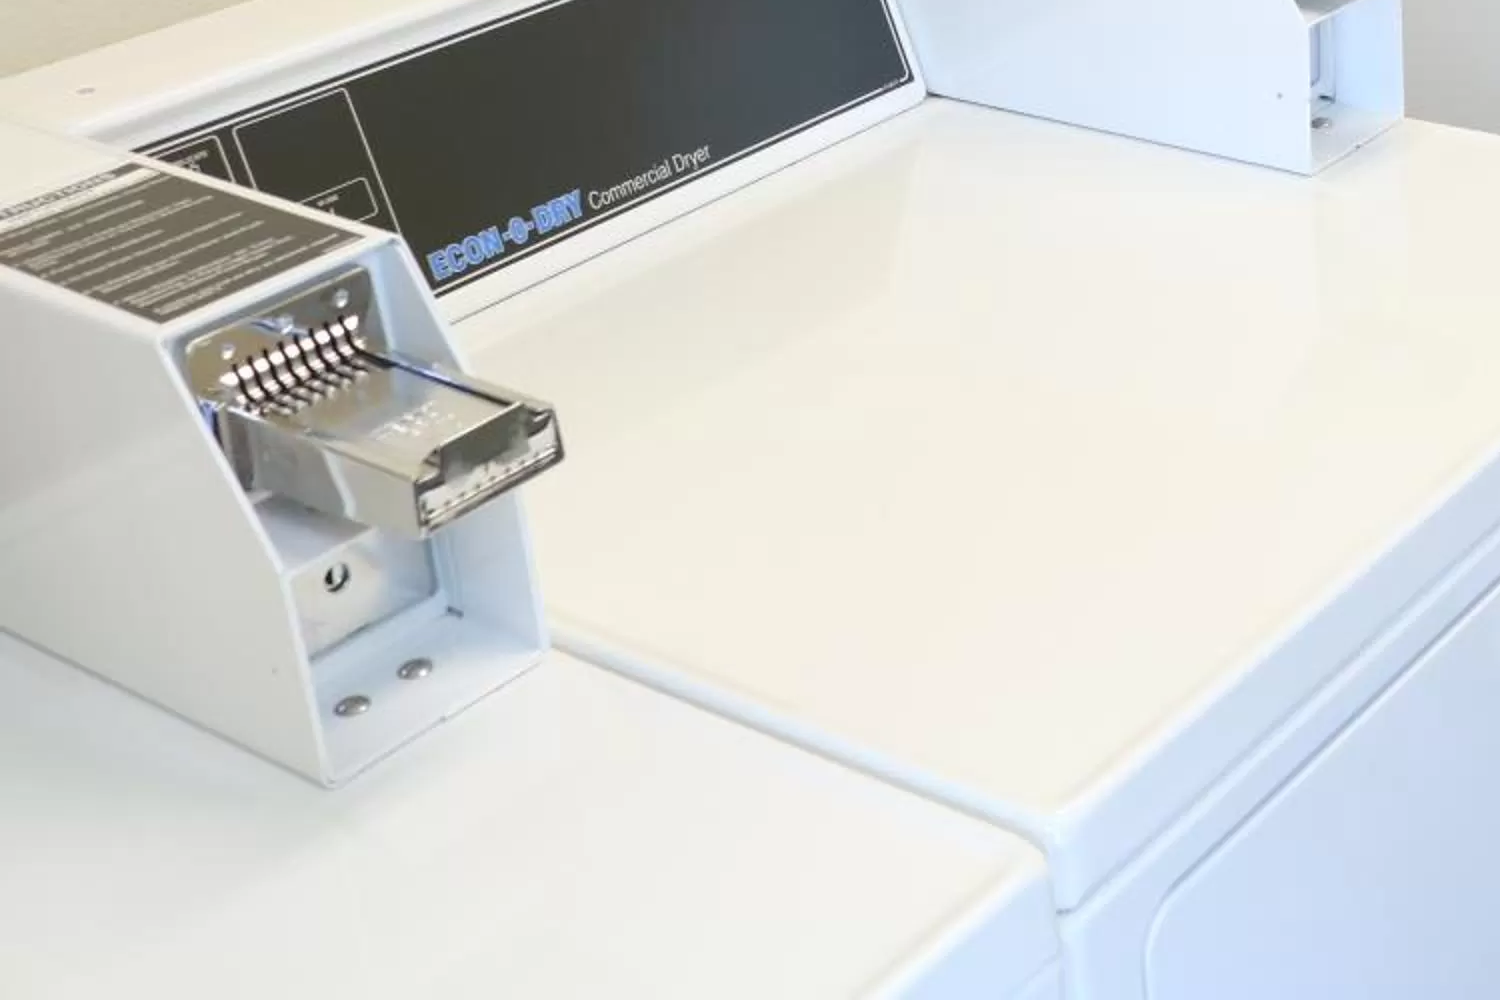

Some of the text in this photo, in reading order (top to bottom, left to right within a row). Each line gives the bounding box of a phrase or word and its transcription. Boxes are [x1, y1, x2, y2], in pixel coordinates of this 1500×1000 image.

[426, 145, 711, 281] ECON-O-DRY Commercial Dryer
